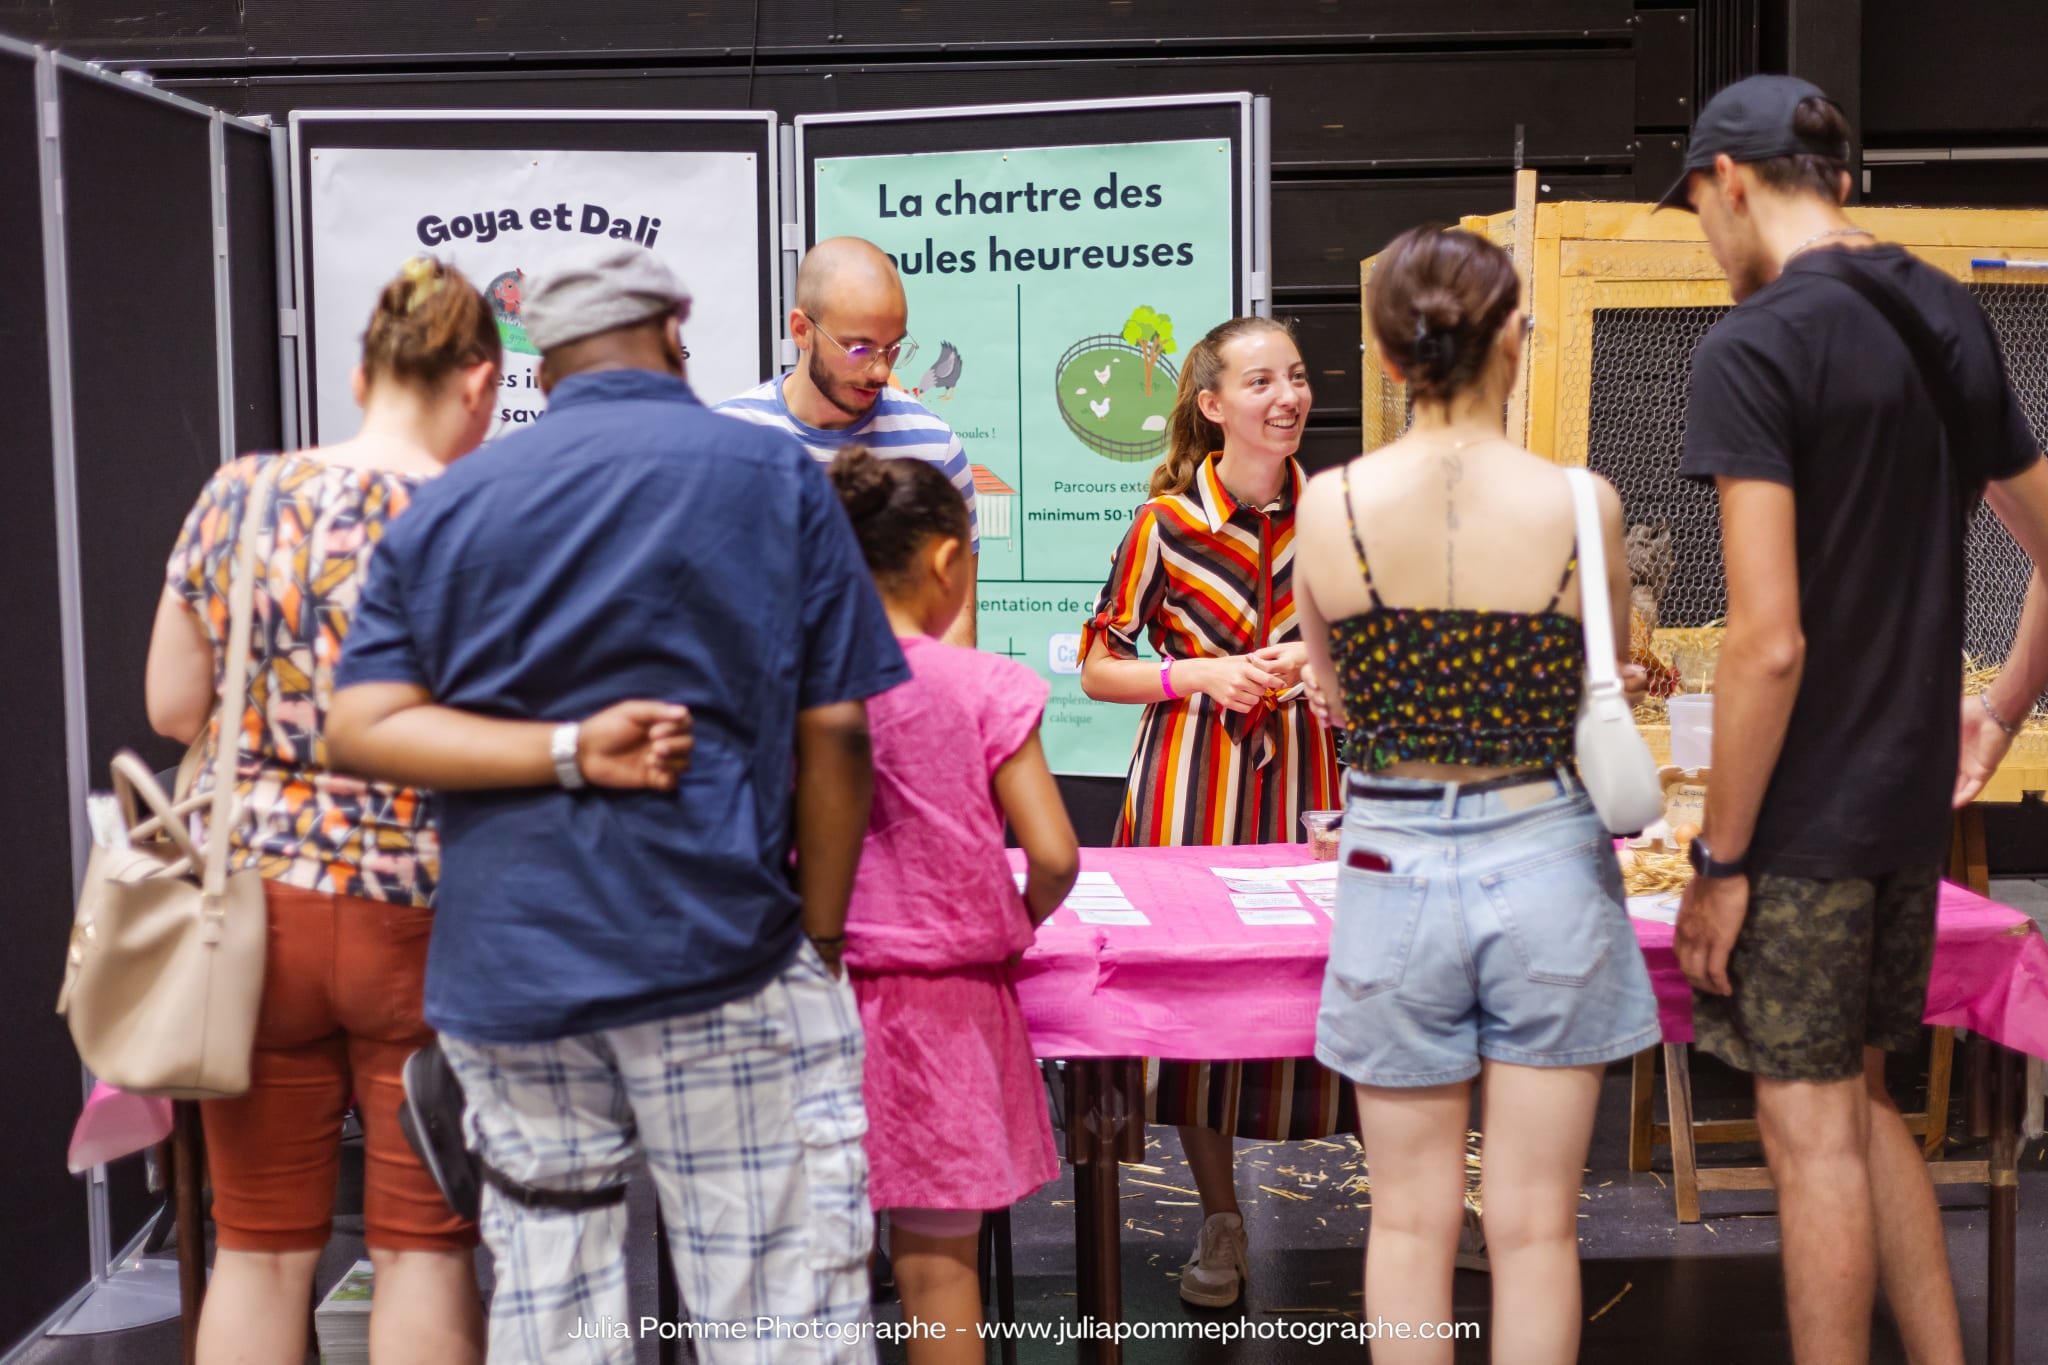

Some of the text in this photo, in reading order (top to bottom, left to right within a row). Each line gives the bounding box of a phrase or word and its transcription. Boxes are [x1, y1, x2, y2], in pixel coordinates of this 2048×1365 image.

[879, 171, 1162, 218] La chartre des
[416, 203, 662, 250] Goya et Dali
[989, 235, 1194, 272] heureuses
[1054, 480, 1117, 493] Parcours
[1027, 507, 1134, 521] minimum 50-1
[976, 597, 1053, 612] entation
[1057, 597, 1080, 612] de
